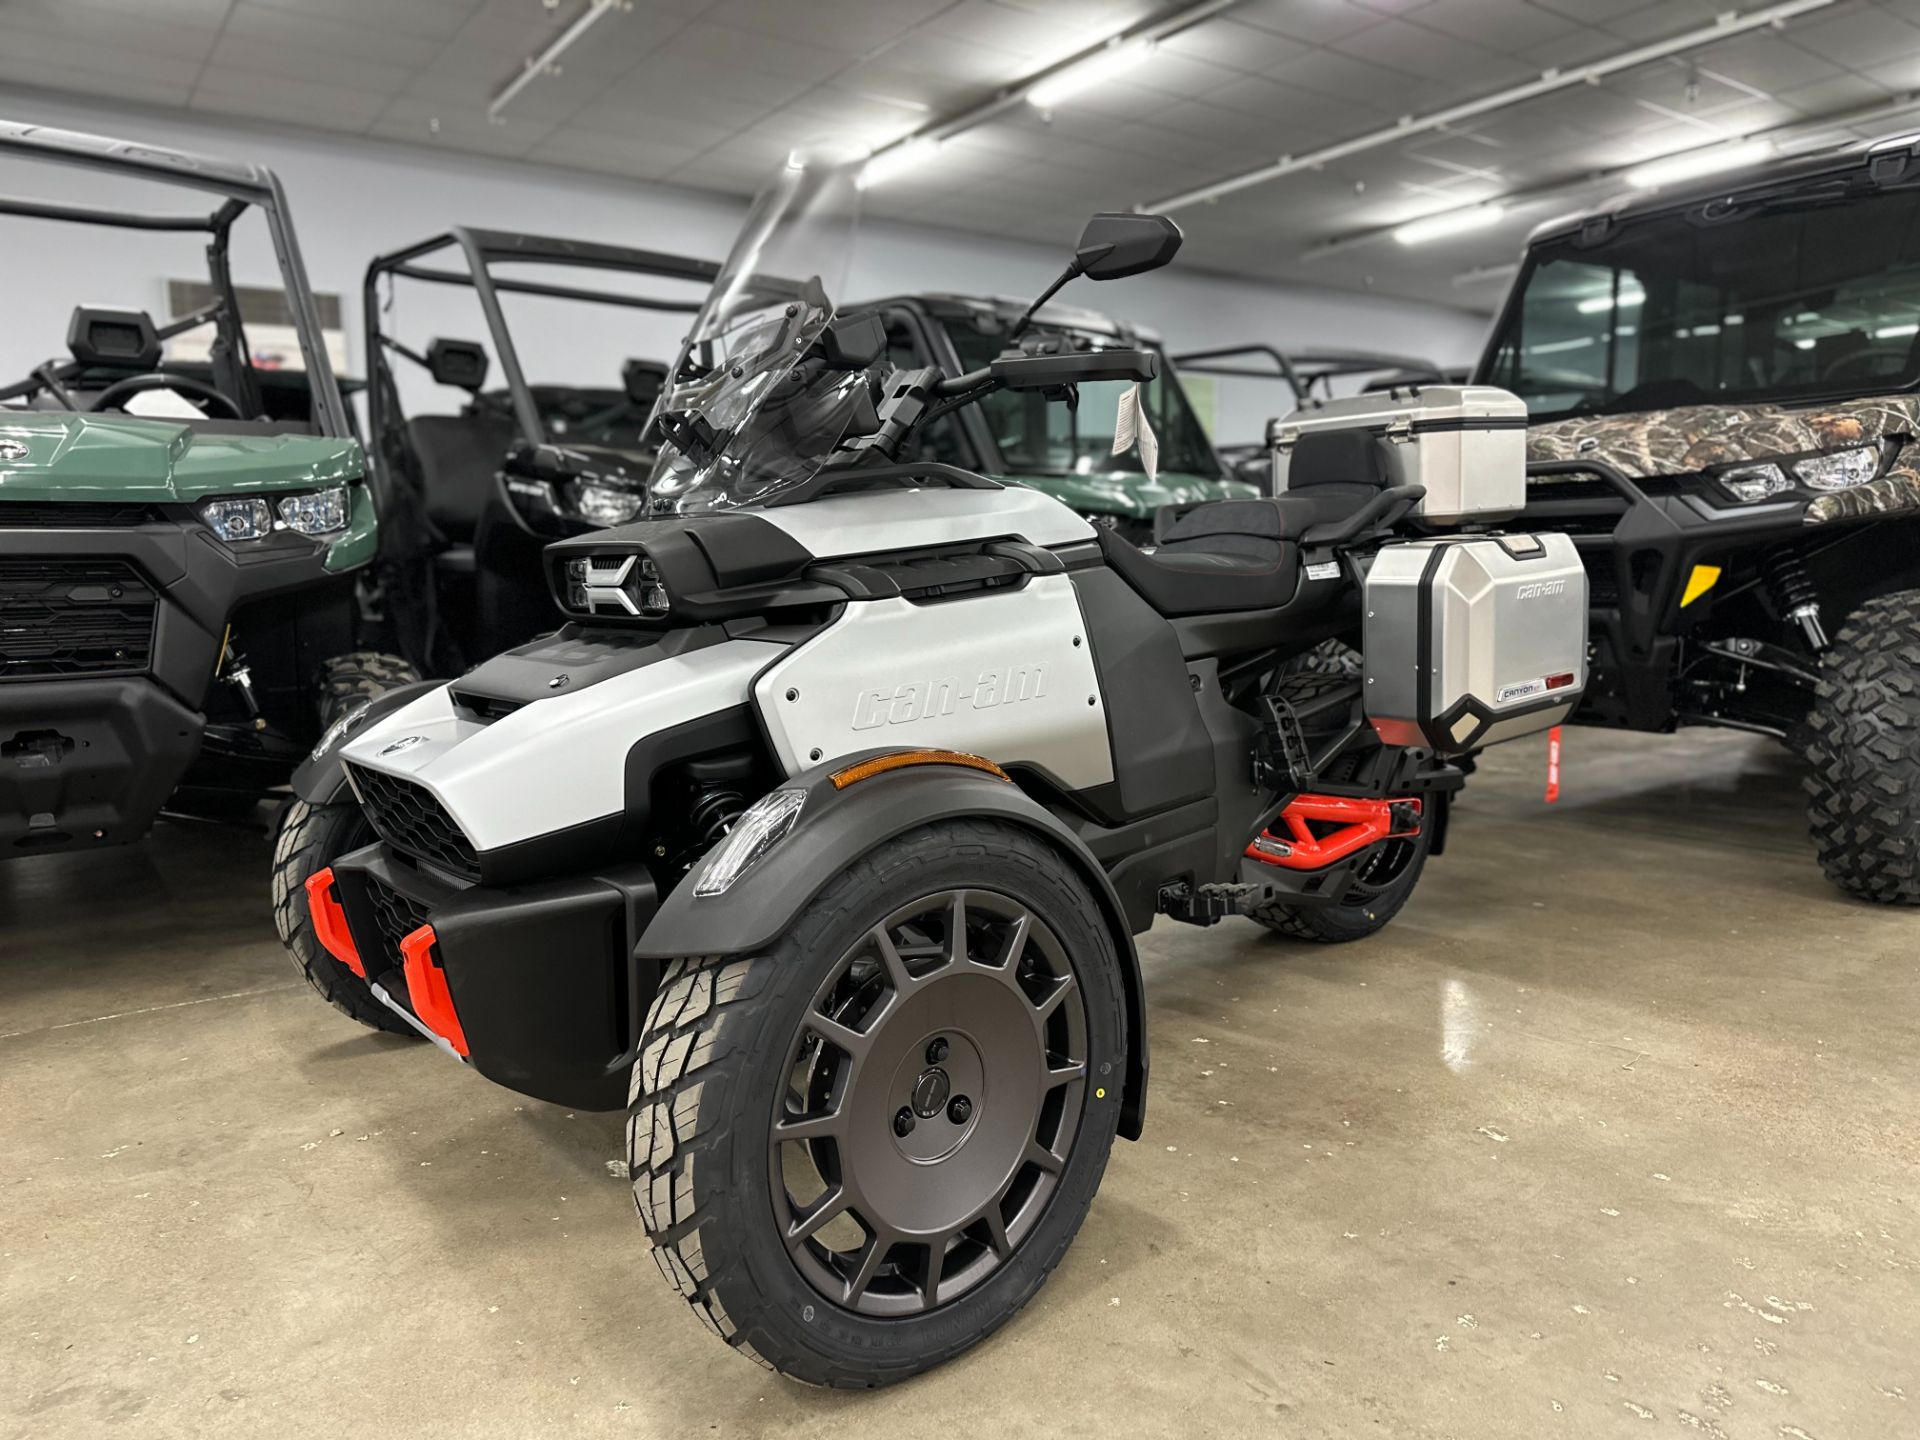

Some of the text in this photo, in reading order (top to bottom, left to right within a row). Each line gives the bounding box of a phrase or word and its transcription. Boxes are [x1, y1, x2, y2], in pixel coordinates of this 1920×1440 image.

[1516, 579, 1566, 600] can-am
[851, 660, 1050, 732] can-am
[1503, 685, 1534, 698] CANYON
